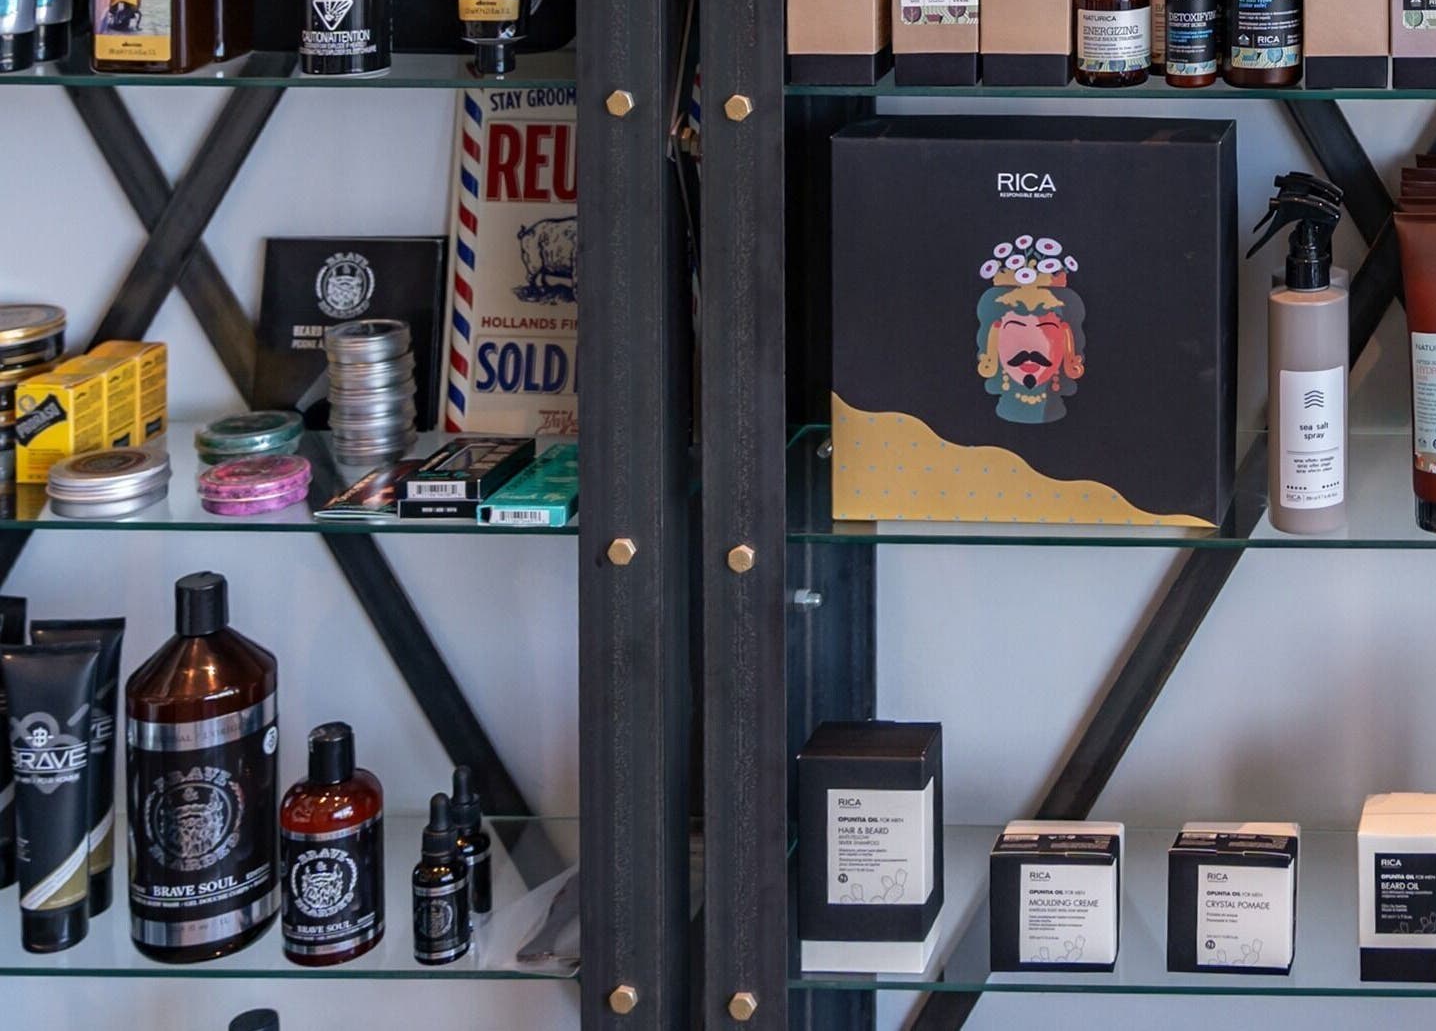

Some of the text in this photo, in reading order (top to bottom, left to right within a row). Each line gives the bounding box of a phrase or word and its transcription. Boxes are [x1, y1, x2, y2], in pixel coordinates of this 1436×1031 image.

[1083, 26, 1138, 36] ENERGIZING
[491, 92, 522, 111] STAY
[998, 173, 1056, 191] RICA
[481, 316, 557, 329] HOLLANDS
[477, 342, 566, 393] SOLD
[1300, 424, 1313, 432] sea
[1304, 432, 1324, 441] spray
[838, 798, 861, 807] RICA
[838, 826, 855, 836] HAIR
[864, 827, 888, 835] BEARD
[1029, 872, 1051, 880] RICA
[1207, 873, 1228, 881] RICA
[153, 876, 237, 897] BRAVE SOUL
[1381, 882, 1405, 890] BEARD
[1029, 899, 1098, 907] MOULDING CREME
[1206, 900, 1235, 910] CRYSTAL
